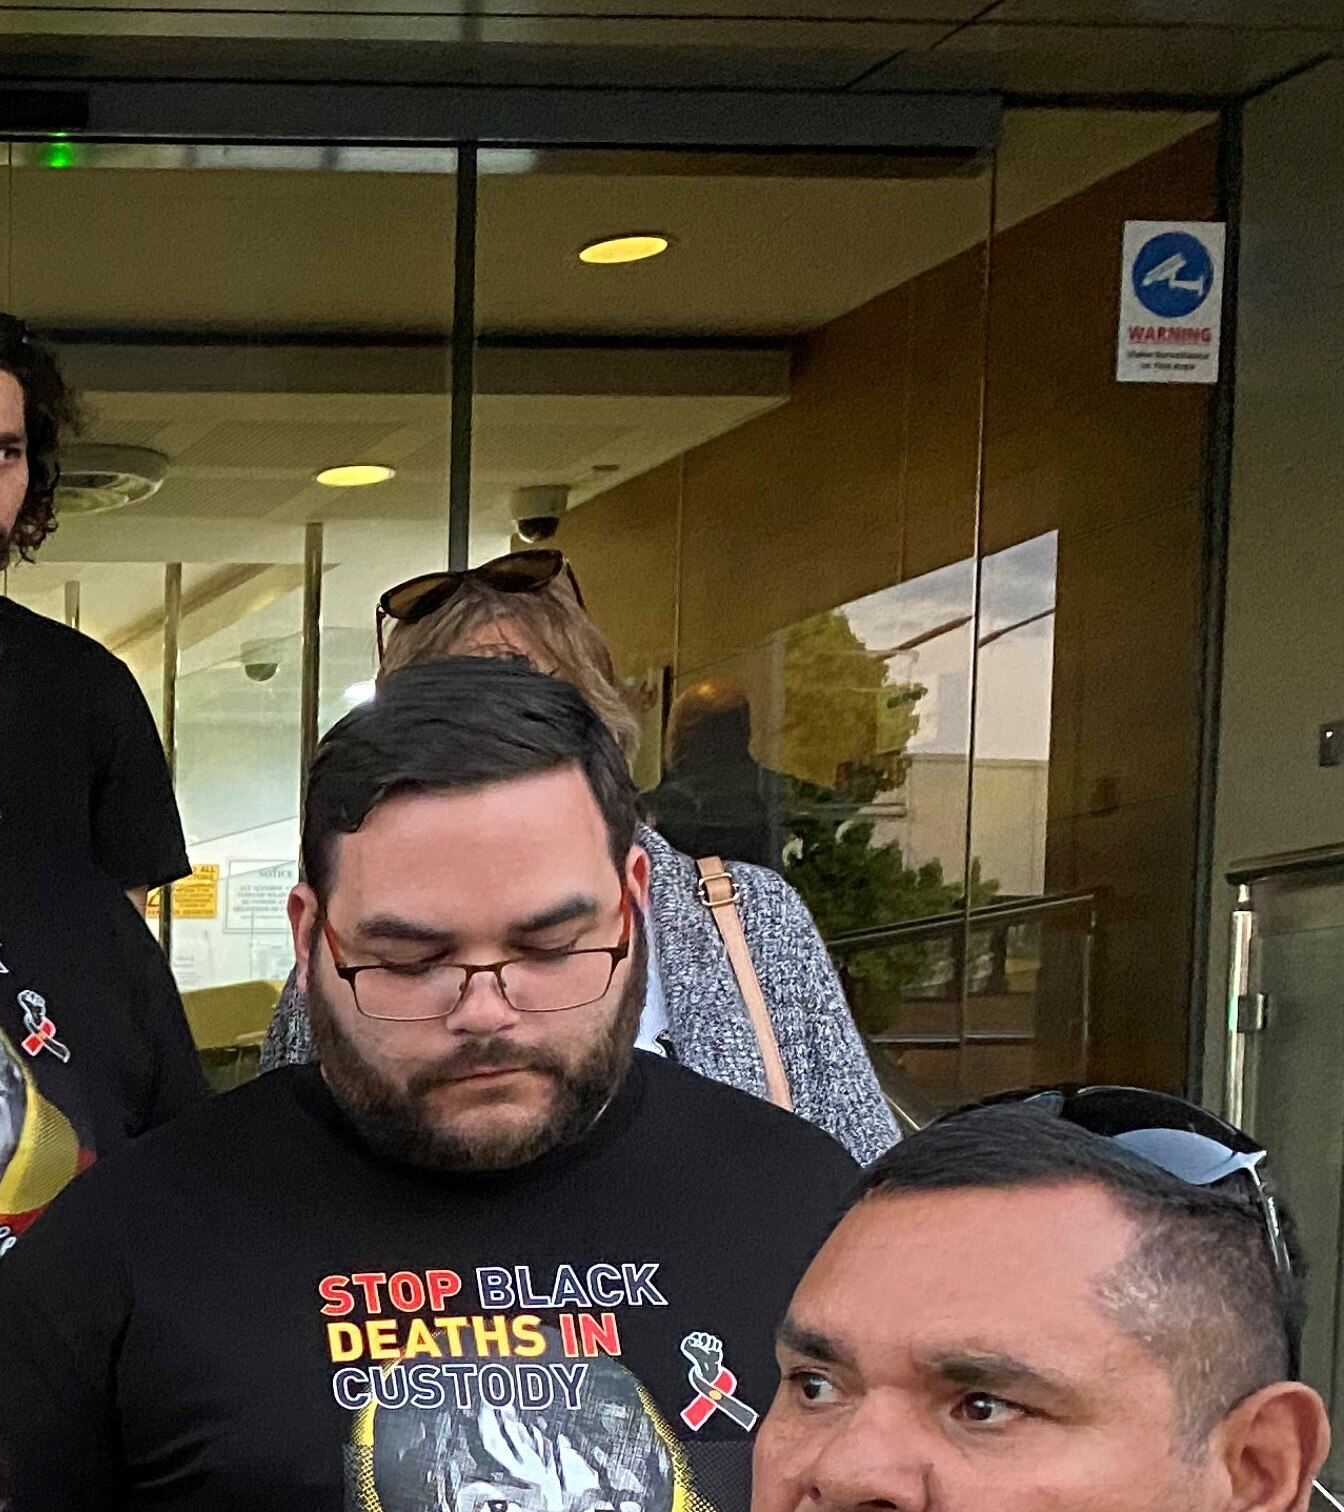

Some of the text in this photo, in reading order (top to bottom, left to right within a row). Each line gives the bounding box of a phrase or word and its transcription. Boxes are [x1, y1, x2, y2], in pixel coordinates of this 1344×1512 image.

[1129, 326, 1212, 344] WARNING
[318, 1262, 669, 1316] STOP BLACK
[326, 1312, 623, 1364] DEATHS IN
[332, 1362, 590, 1411] CUSTODY
